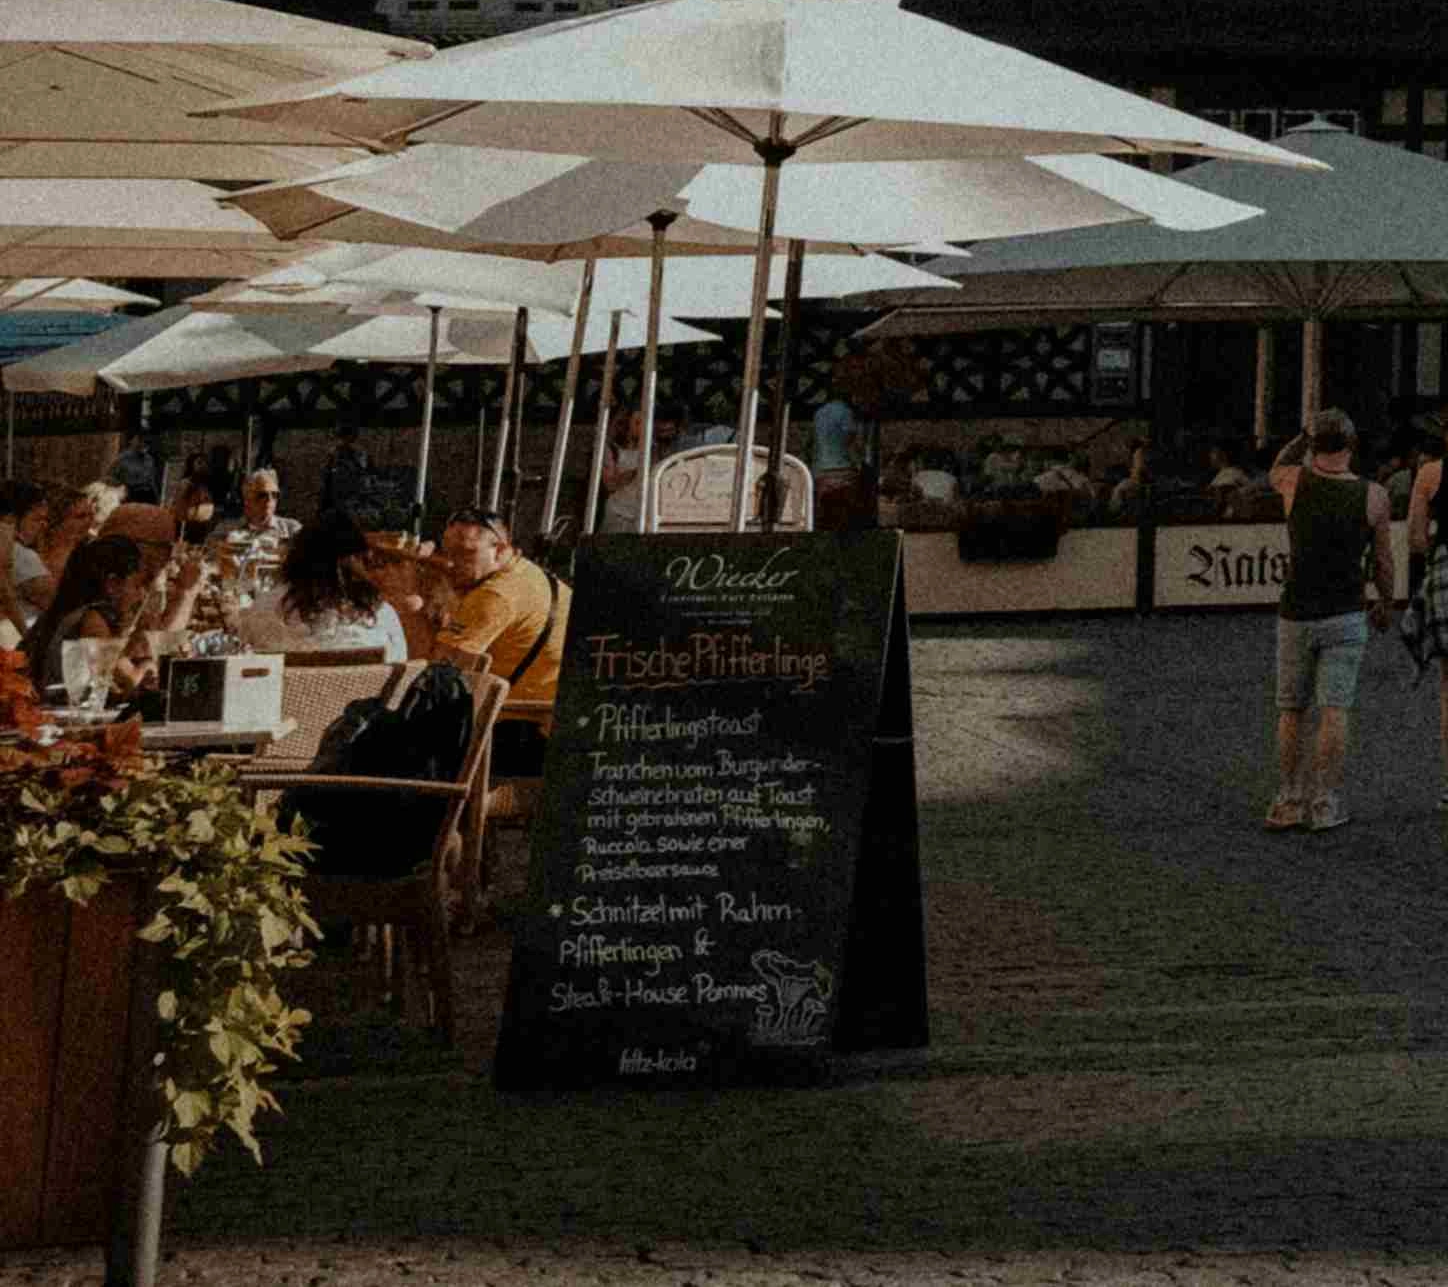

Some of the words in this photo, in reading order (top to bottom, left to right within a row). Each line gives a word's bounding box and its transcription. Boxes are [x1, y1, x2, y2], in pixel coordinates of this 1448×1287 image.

[665, 546, 800, 590] Wiecker
[586, 633, 689, 681] Frische
[689, 632, 828, 692] Pfifferlinge
[593, 703, 763, 750] Pfifferlingstoast
[587, 751, 673, 781] Tranchen
[726, 784, 762, 809] auf
[757, 780, 817, 805] Toast
[586, 809, 621, 829] mit
[624, 809, 718, 835] gebratenen
[582, 834, 650, 855] Ruccola
[706, 829, 750, 853] einer
[570, 892, 667, 927] Schnitzel
[668, 893, 710, 923] mit
[559, 933, 684, 978] Pfifferlingen
[692, 972, 769, 1005] Pommes
